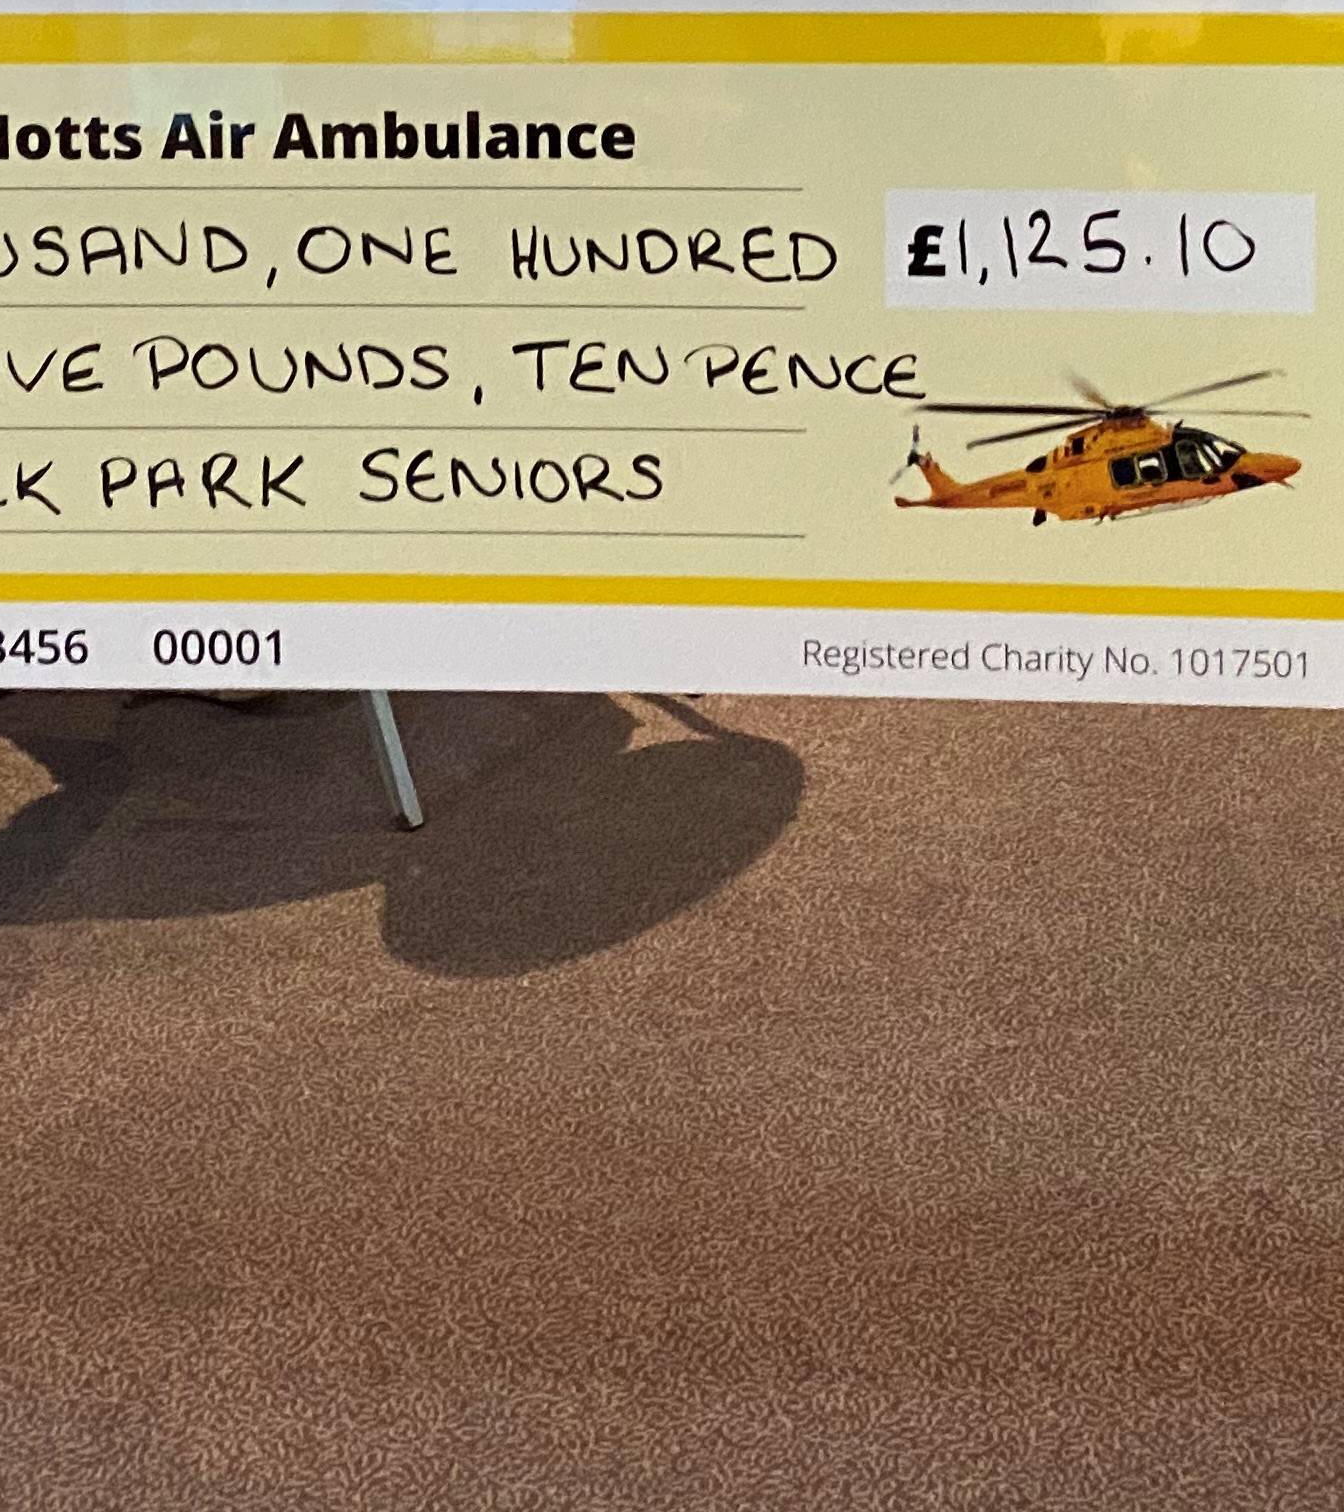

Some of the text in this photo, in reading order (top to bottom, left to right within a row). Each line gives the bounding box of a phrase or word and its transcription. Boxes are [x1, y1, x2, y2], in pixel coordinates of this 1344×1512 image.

[160, 109, 256, 160] Air
[272, 110, 636, 160] Ambulance
[297, 225, 458, 276] ONE
[511, 224, 838, 283] HUNDRED
[907, 208, 1256, 286] £1,125.10
[132, 335, 483, 406] POUNDS,
[511, 338, 669, 394] TEN
[683, 344, 927, 400] PENCE
[100, 452, 307, 510] PARK
[359, 446, 663, 504] SENIORS
[153, 628, 281, 666] 00001
[803, 639, 1307, 682] Registered Charity No. 1017501
